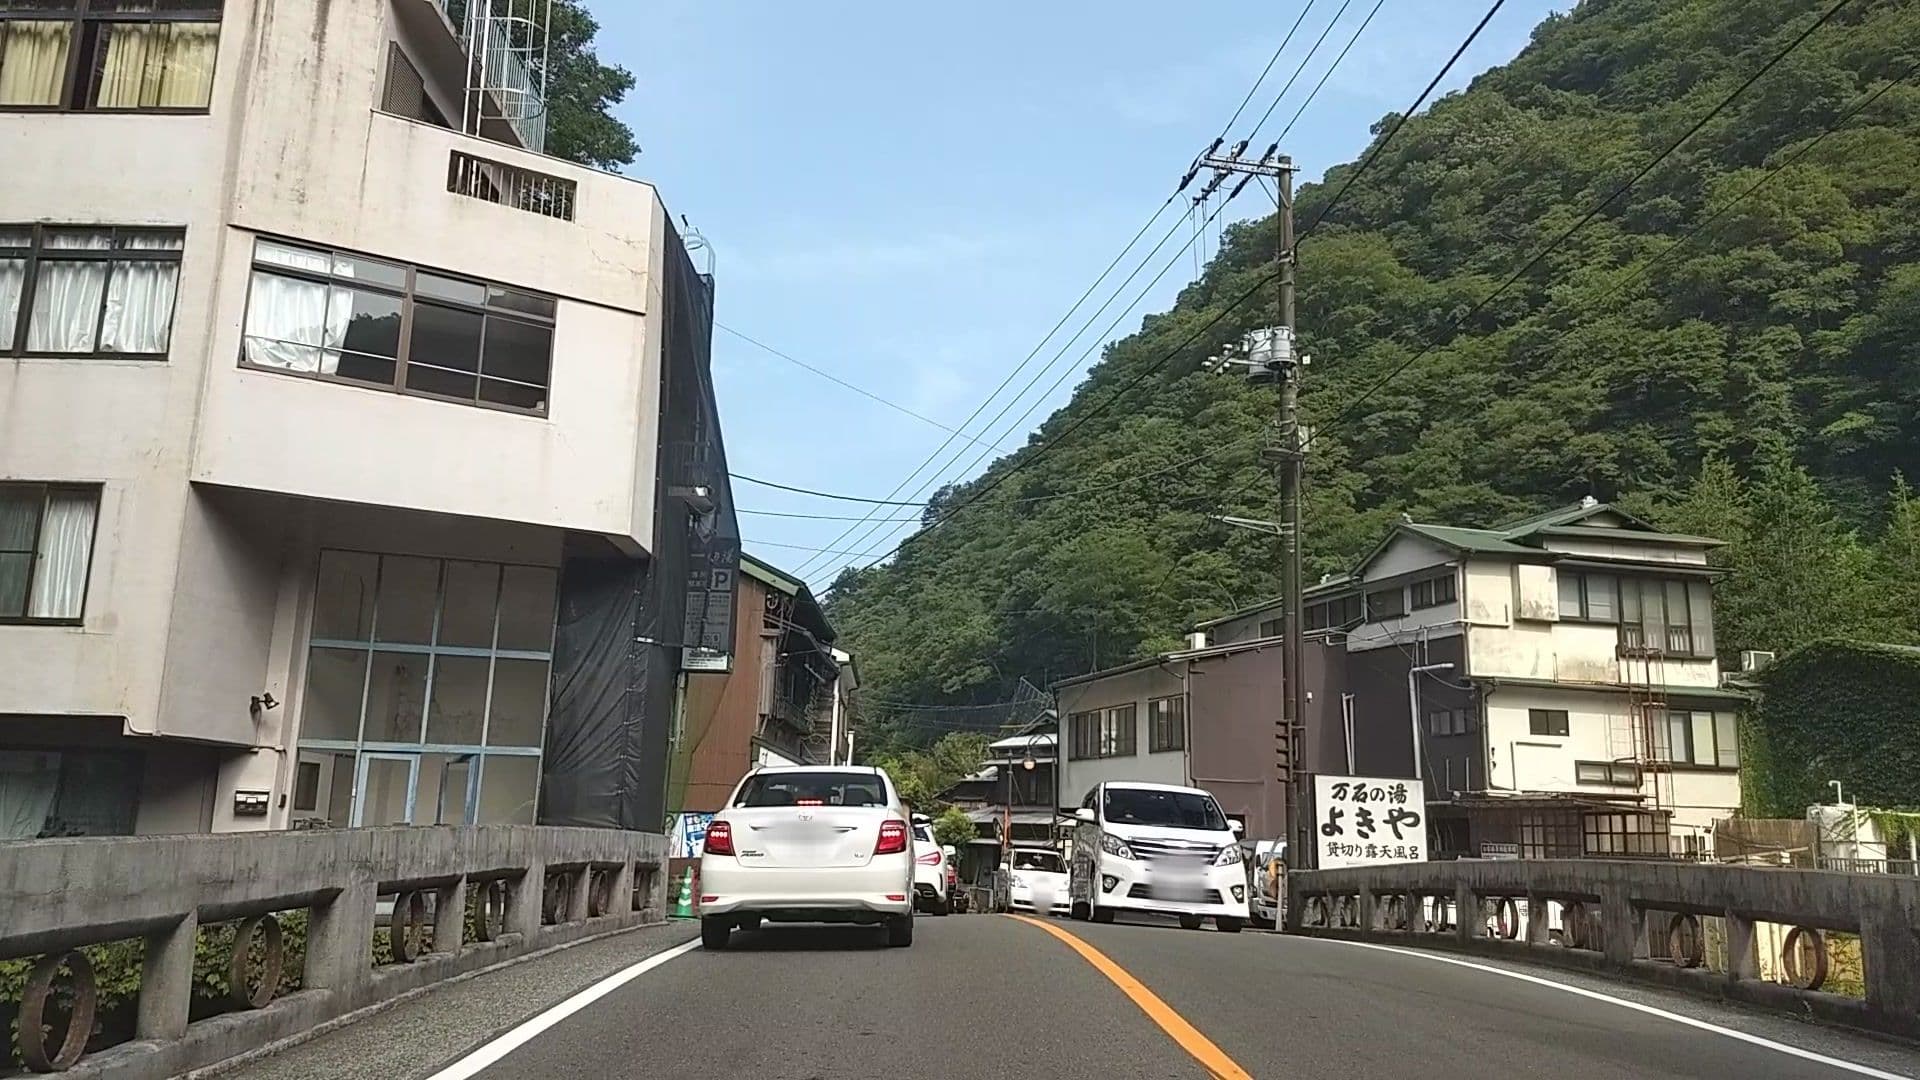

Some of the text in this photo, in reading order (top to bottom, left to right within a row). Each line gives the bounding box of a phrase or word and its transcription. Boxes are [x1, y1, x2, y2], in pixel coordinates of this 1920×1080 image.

[714, 571, 728, 588] P
[1331, 782, 1408, 804] 万石の湯
[1321, 806, 1421, 840] よきや
[1327, 842, 1419, 860] 貸切り露天風呂
